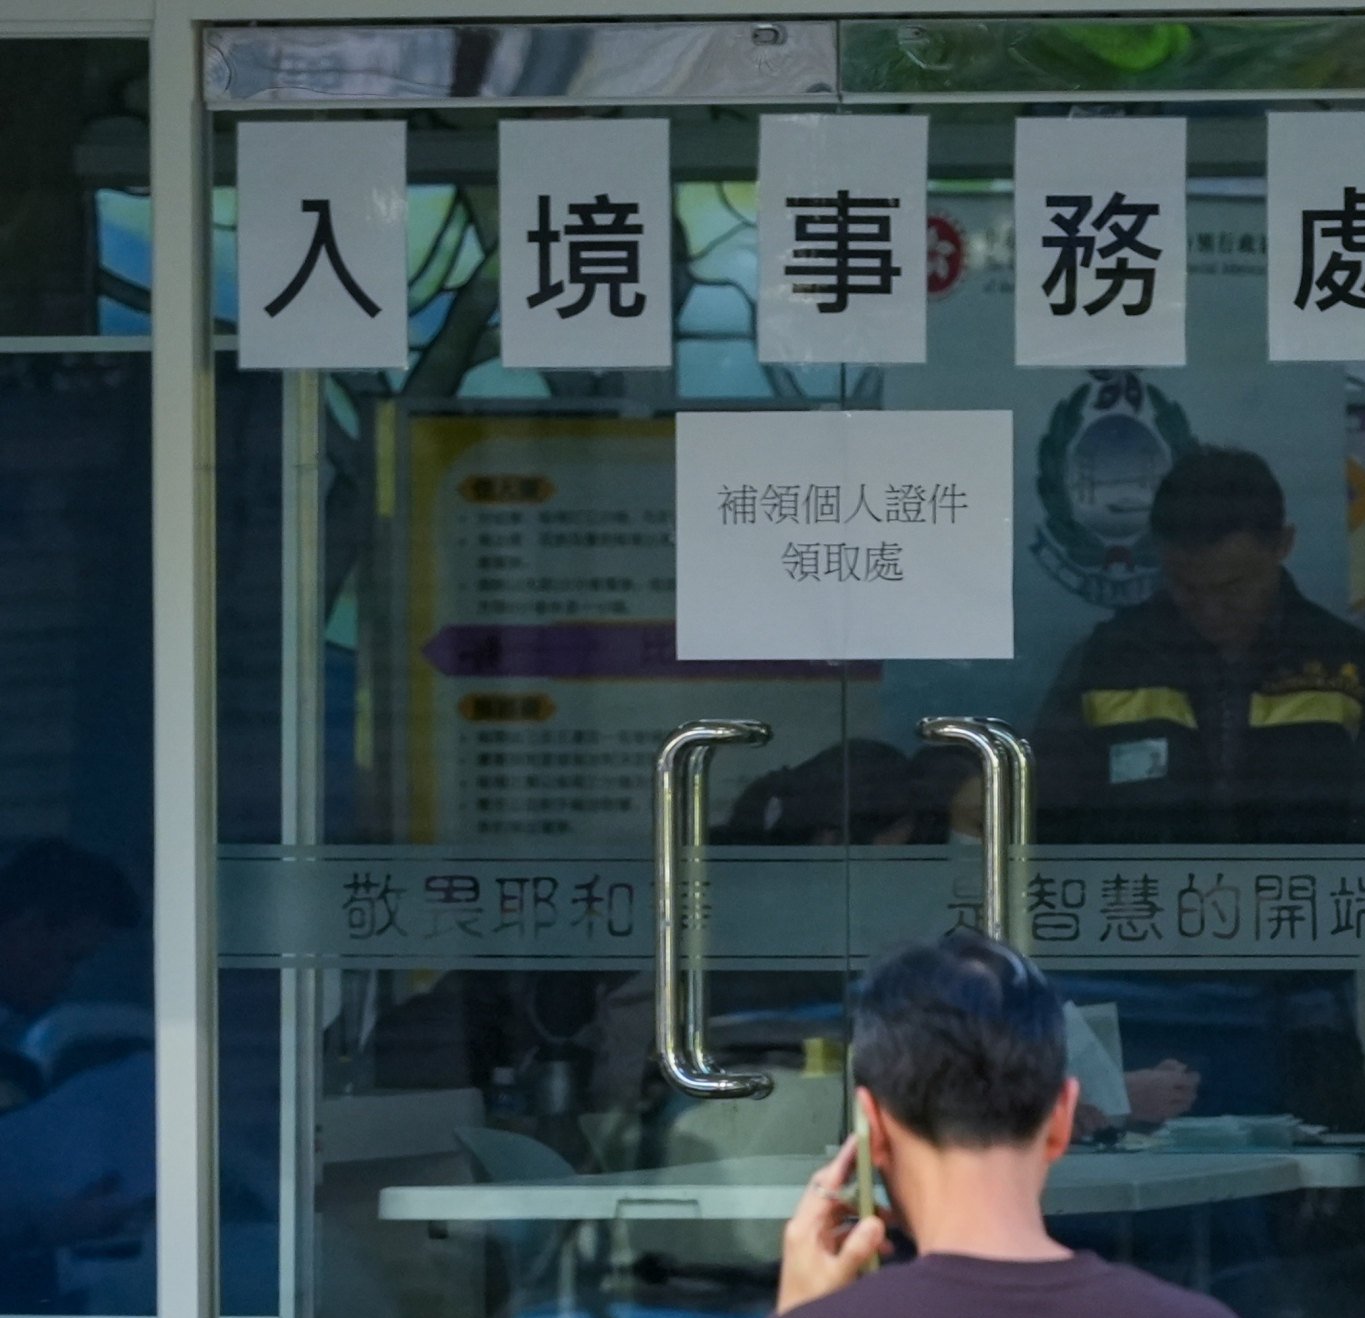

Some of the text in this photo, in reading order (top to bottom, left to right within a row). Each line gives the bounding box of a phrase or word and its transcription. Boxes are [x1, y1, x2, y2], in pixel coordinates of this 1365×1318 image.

[717, 483, 968, 525] 補領個人證件
[781, 541, 904, 583] 領取處
